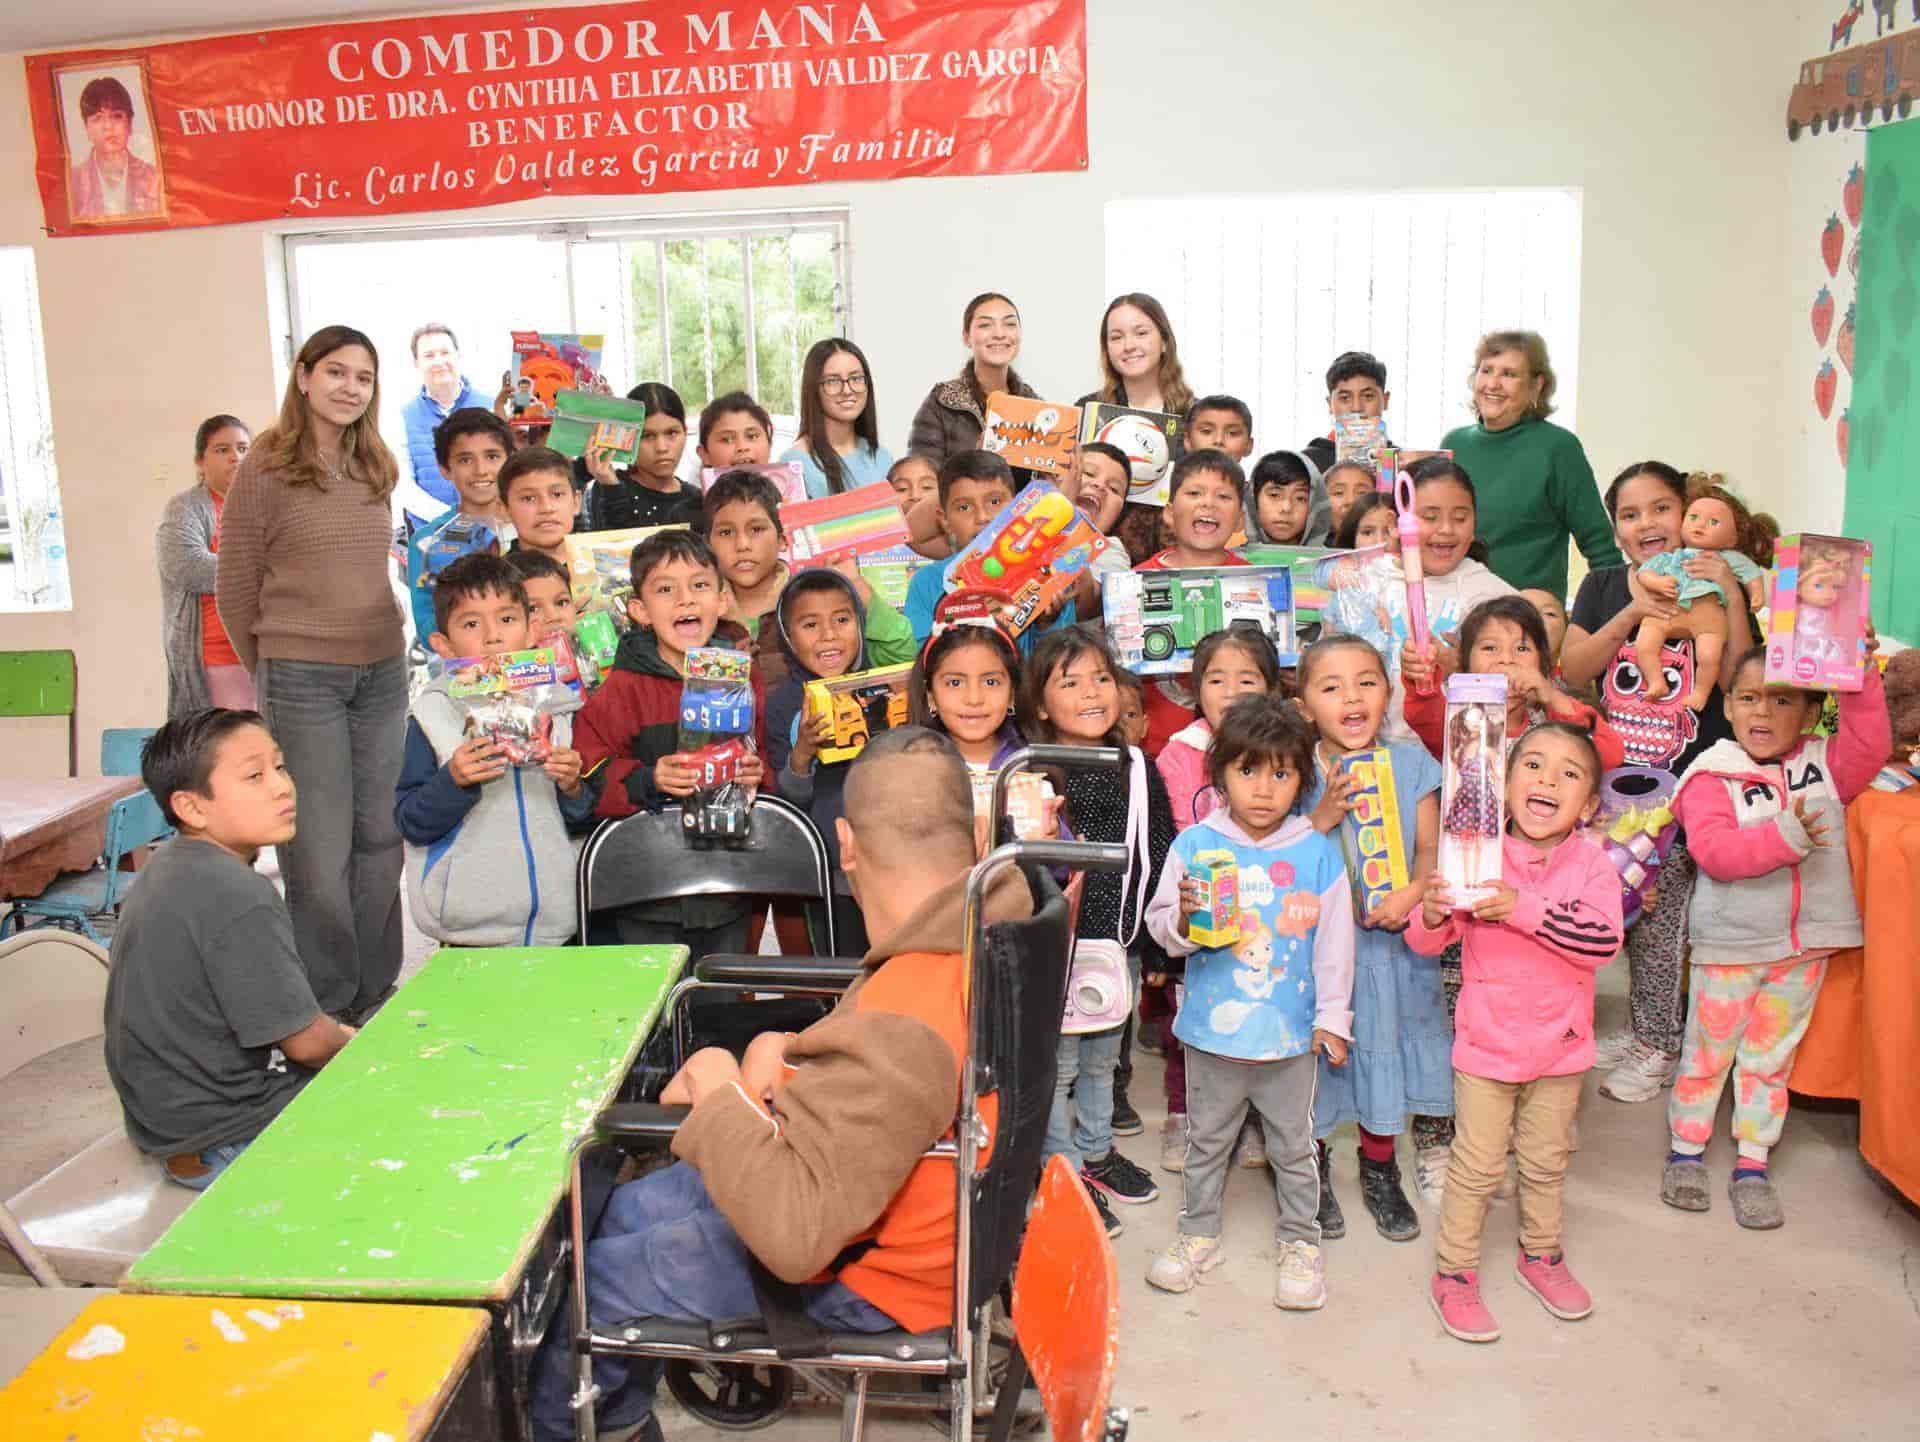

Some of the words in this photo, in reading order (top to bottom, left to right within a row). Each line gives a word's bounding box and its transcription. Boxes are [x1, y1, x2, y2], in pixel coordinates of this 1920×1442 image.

[329, 21, 662, 82] COMEDOR
[686, 3, 885, 53] MANA
[180, 109, 217, 136] EN
[226, 99, 325, 131] HONOR
[336, 95, 377, 122] DE
[388, 89, 457, 119] DRA.
[468, 77, 599, 111] CYNTHIA
[611, 63, 793, 99] ELIZABETH
[804, 54, 931, 89] VALDEZ
[942, 45, 1062, 79] GARCIA
[468, 103, 752, 147] BENEFACTOR
[291, 173, 350, 209] Lic.
[366, 162, 475, 205] Carlos
[496, 150, 619, 185] Valdez
[633, 142, 759, 187] Garcia
[768, 147, 789, 177] y
[798, 129, 955, 176] Familia
